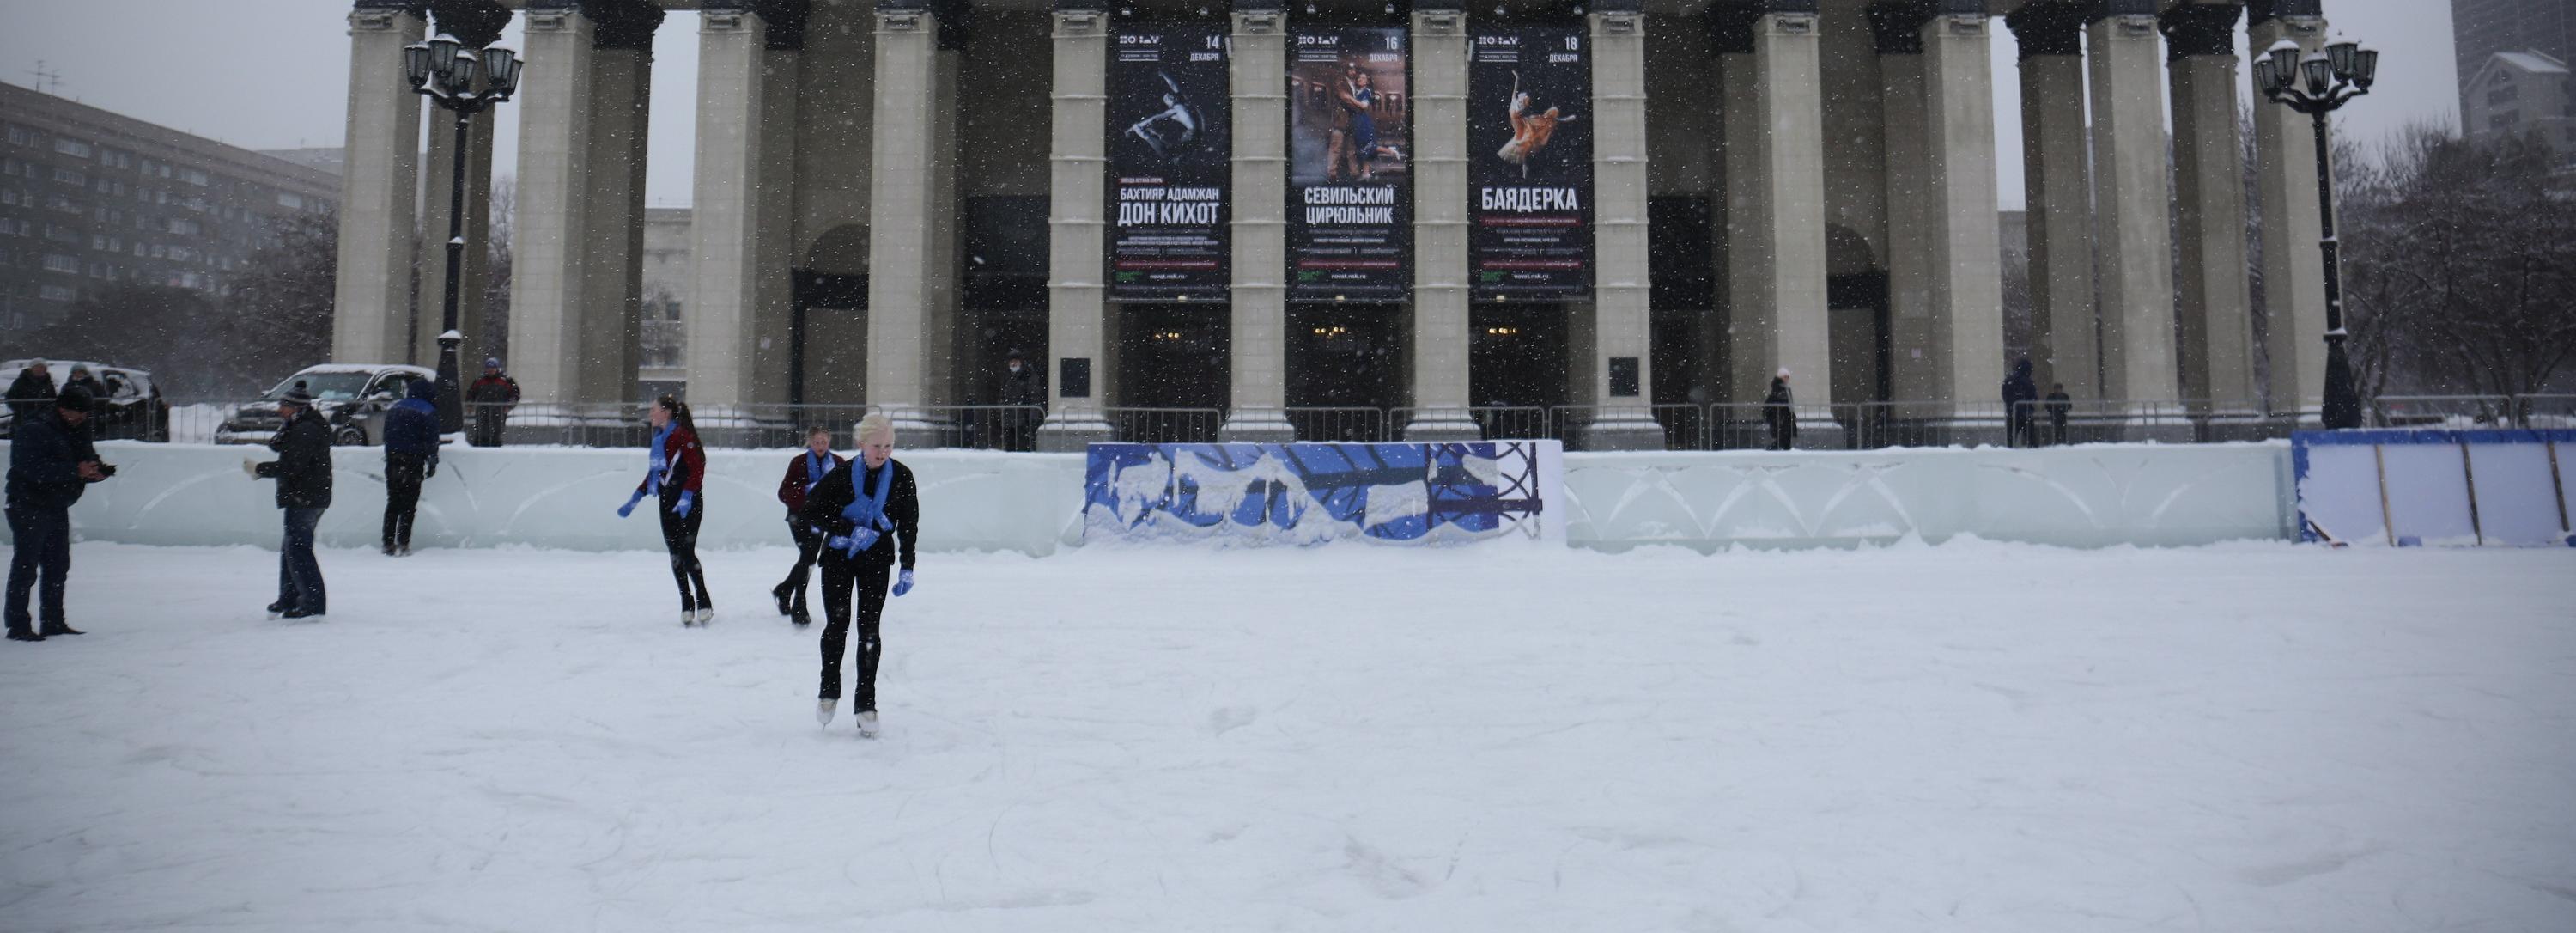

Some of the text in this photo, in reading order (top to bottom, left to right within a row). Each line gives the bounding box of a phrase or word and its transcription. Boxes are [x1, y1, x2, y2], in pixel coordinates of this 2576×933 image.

[1206, 35, 1219, 49] 14
[1385, 36, 1398, 50] 16
[1564, 36, 1577, 50] 18
[1189, 52, 1219, 62] ДЕКАБРЯ
[1369, 53, 1398, 62] ДЕКАБРЯ
[1548, 53, 1577, 62] ДЕКАБРЯ
[1120, 188, 1218, 201] БАХТИЯР АДАМЖАН
[1304, 185, 1394, 204] СЕВИЛЬСКИЙ
[1481, 187, 1577, 212] БАЯДЕРКА
[1117, 202, 1219, 226] ДОН КИХОТ
[1305, 206, 1393, 226] ЦИРЮЛЬНИК
